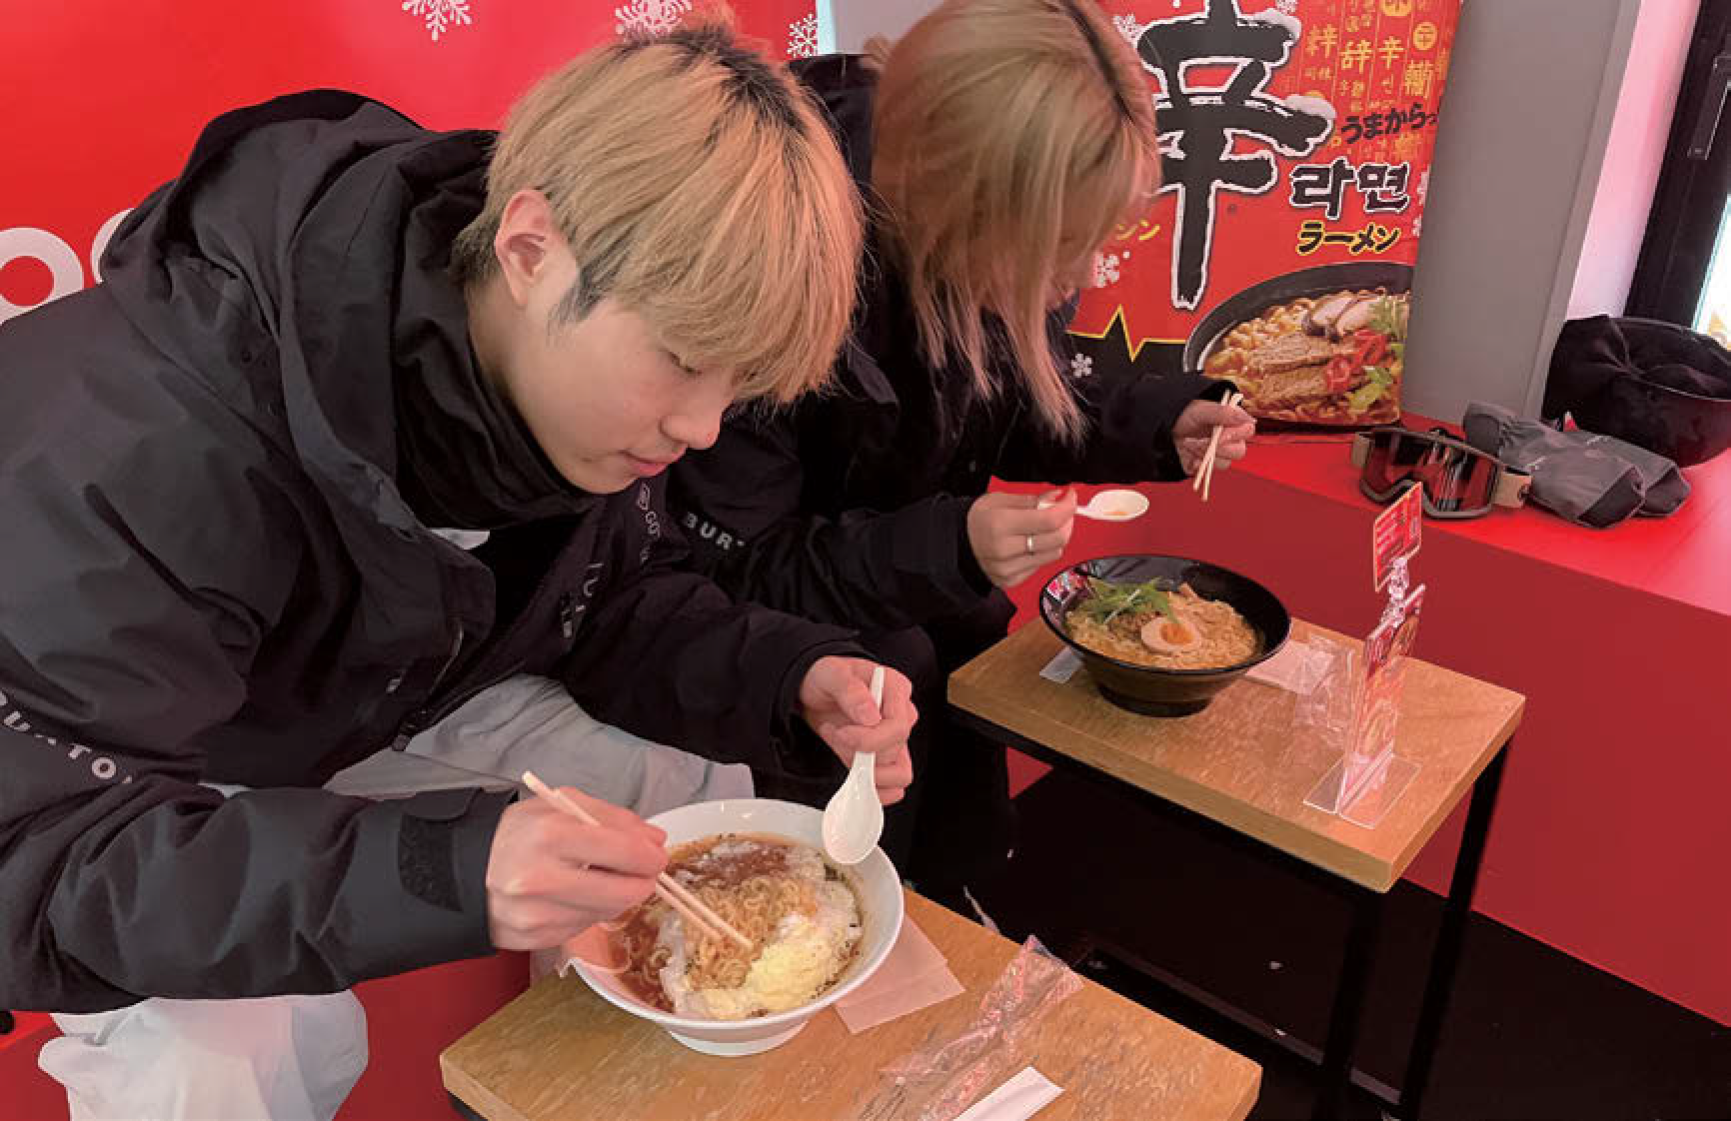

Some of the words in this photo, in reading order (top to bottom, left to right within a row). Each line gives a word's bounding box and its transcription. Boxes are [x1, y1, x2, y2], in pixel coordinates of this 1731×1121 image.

[1137, 0, 1336, 310] 辛
[1289, 155, 1410, 220] 라면
[1296, 220, 1400, 255] ラーメン
[683, 512, 745, 551] BUR
